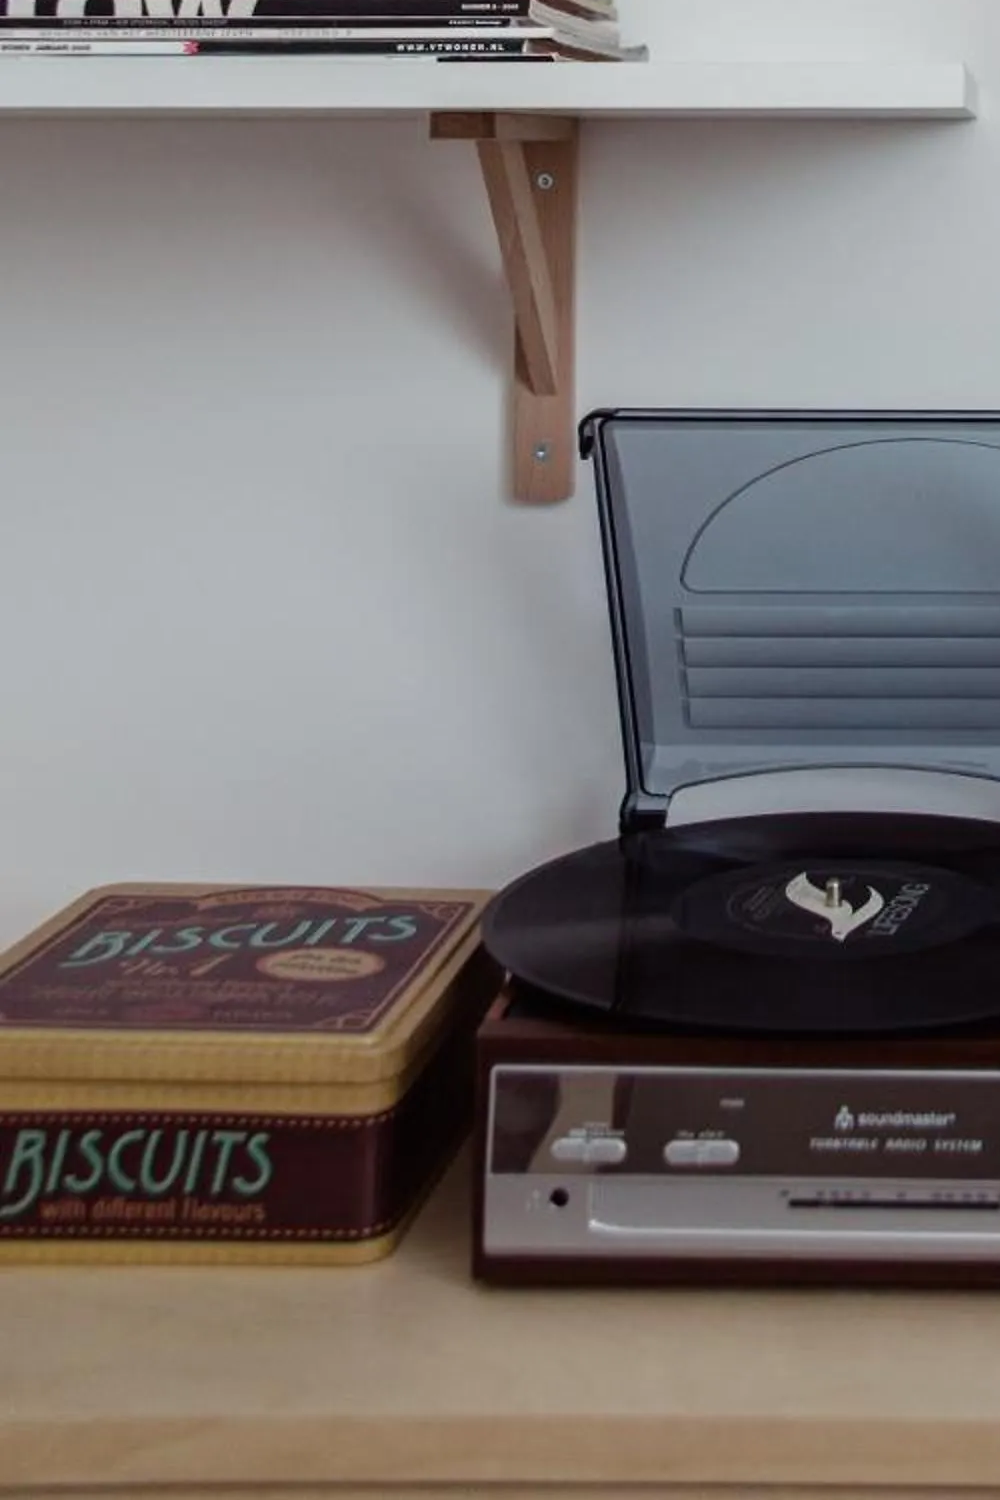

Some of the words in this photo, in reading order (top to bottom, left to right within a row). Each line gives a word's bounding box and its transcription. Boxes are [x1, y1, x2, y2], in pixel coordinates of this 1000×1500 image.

[59, 915, 417, 968] BISCUITS
[0, 1129, 272, 1217] BISCUITS
[91, 1199, 177, 1221] different
